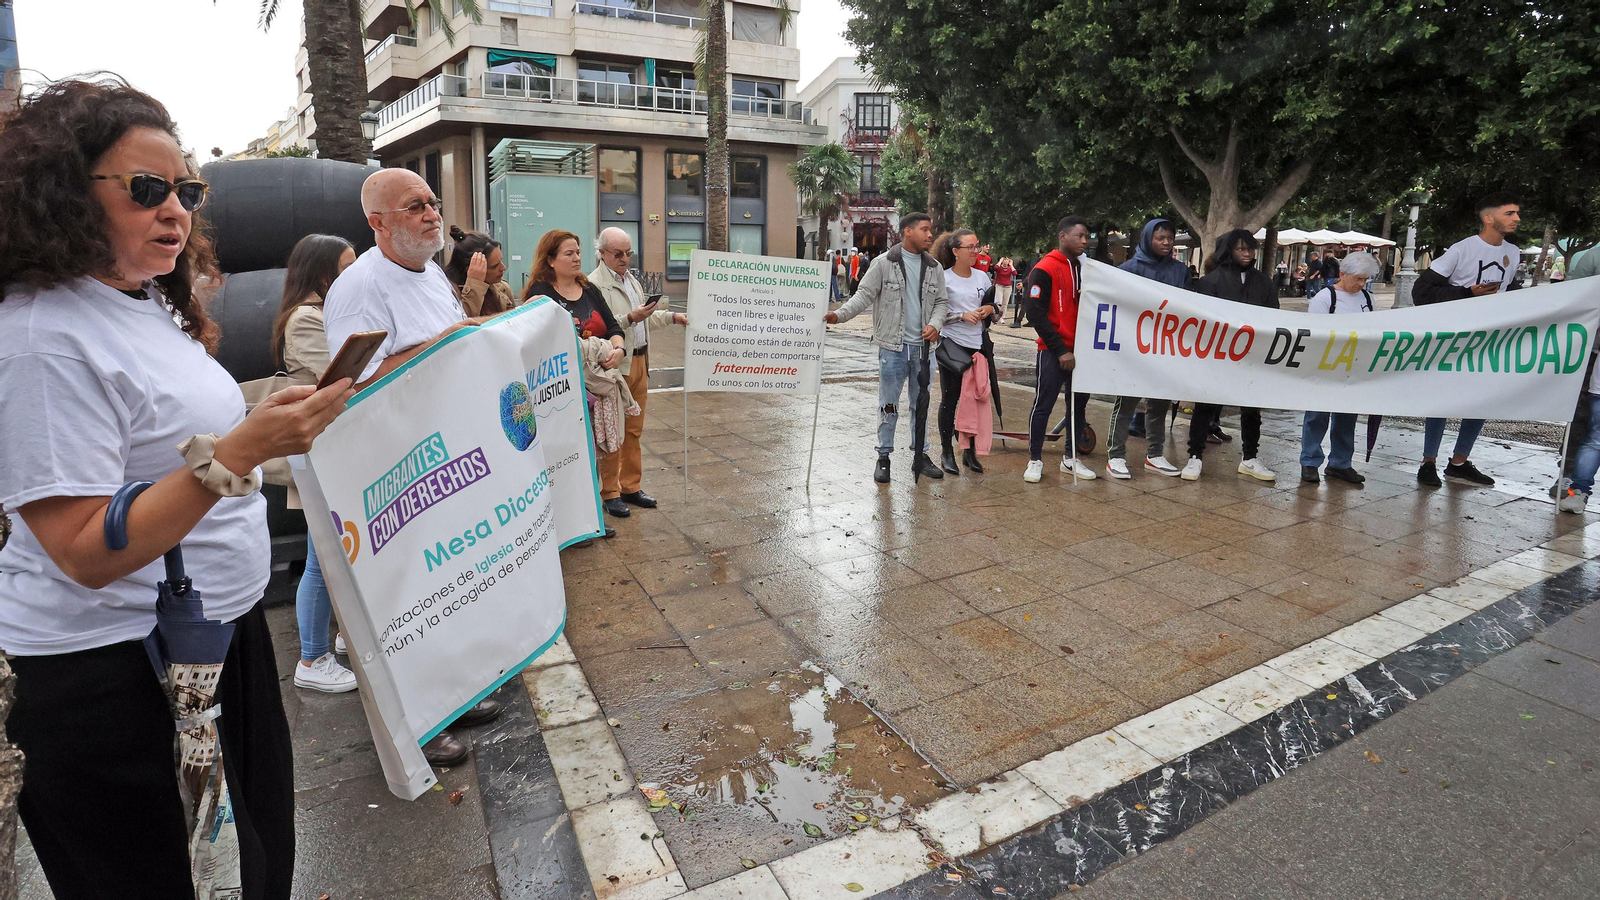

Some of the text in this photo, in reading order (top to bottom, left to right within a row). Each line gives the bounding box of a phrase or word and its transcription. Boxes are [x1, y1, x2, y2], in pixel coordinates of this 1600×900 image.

[708, 258, 820, 276] DECLARACIÓN UNIVERSAL
[697, 271, 827, 290] DE LOS DERECHOS HUMANOS:
[740, 296, 752, 305] los
[754, 298, 776, 307] seres
[777, 298, 816, 309] humanos
[716, 309, 742, 318] nacen
[745, 309, 767, 319] libres
[776, 311, 805, 322] iguales
[707, 321, 812, 336] en dignidad y derechos y,
[1093, 299, 1588, 375] EL CÍRCULO DE LA FRATERNIDAD
[693, 333, 822, 349] dotados como están de razón y
[691, 348, 821, 361] conciencia, deben comportarse
[712, 362, 798, 376] fraternalmente
[538, 378, 571, 406] JUSTICIA
[707, 378, 720, 387] los
[721, 380, 743, 388] unos
[761, 380, 773, 388] los
[546, 452, 579, 476] de la casa
[367, 436, 446, 517] MIGRANTES
[371, 452, 487, 550] CON DERECHOS
[423, 469, 549, 573] Mesa Diocesa
[456, 570, 474, 586] de
[474, 543, 514, 575] Iglesia
[515, 528, 533, 548] que
[415, 624, 424, 639] y
[425, 614, 440, 628] la
[442, 576, 496, 618] acogida
[497, 561, 514, 579] de
[515, 530, 548, 569] personas
